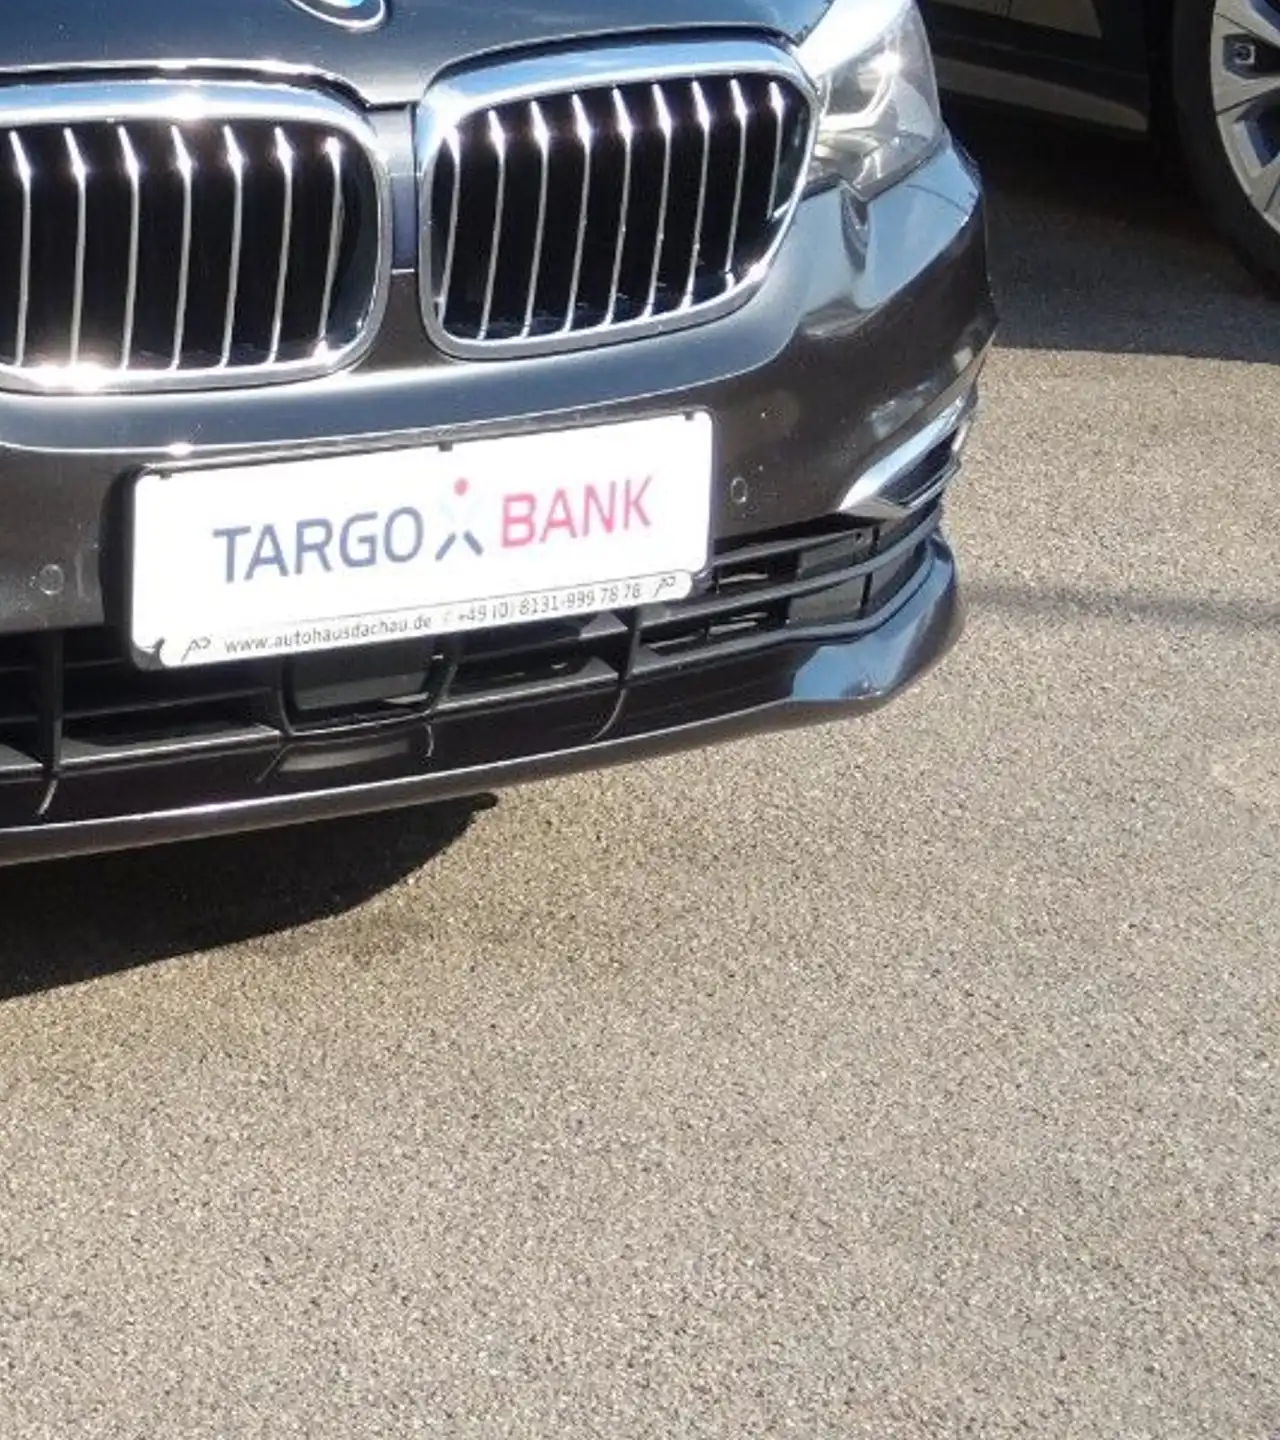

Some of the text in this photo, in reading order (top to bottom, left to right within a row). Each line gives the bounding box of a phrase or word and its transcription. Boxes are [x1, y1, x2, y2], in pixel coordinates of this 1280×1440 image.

[212, 475, 653, 585] TARGO BANK
[224, 613, 433, 655] www.autohausdachau.de
